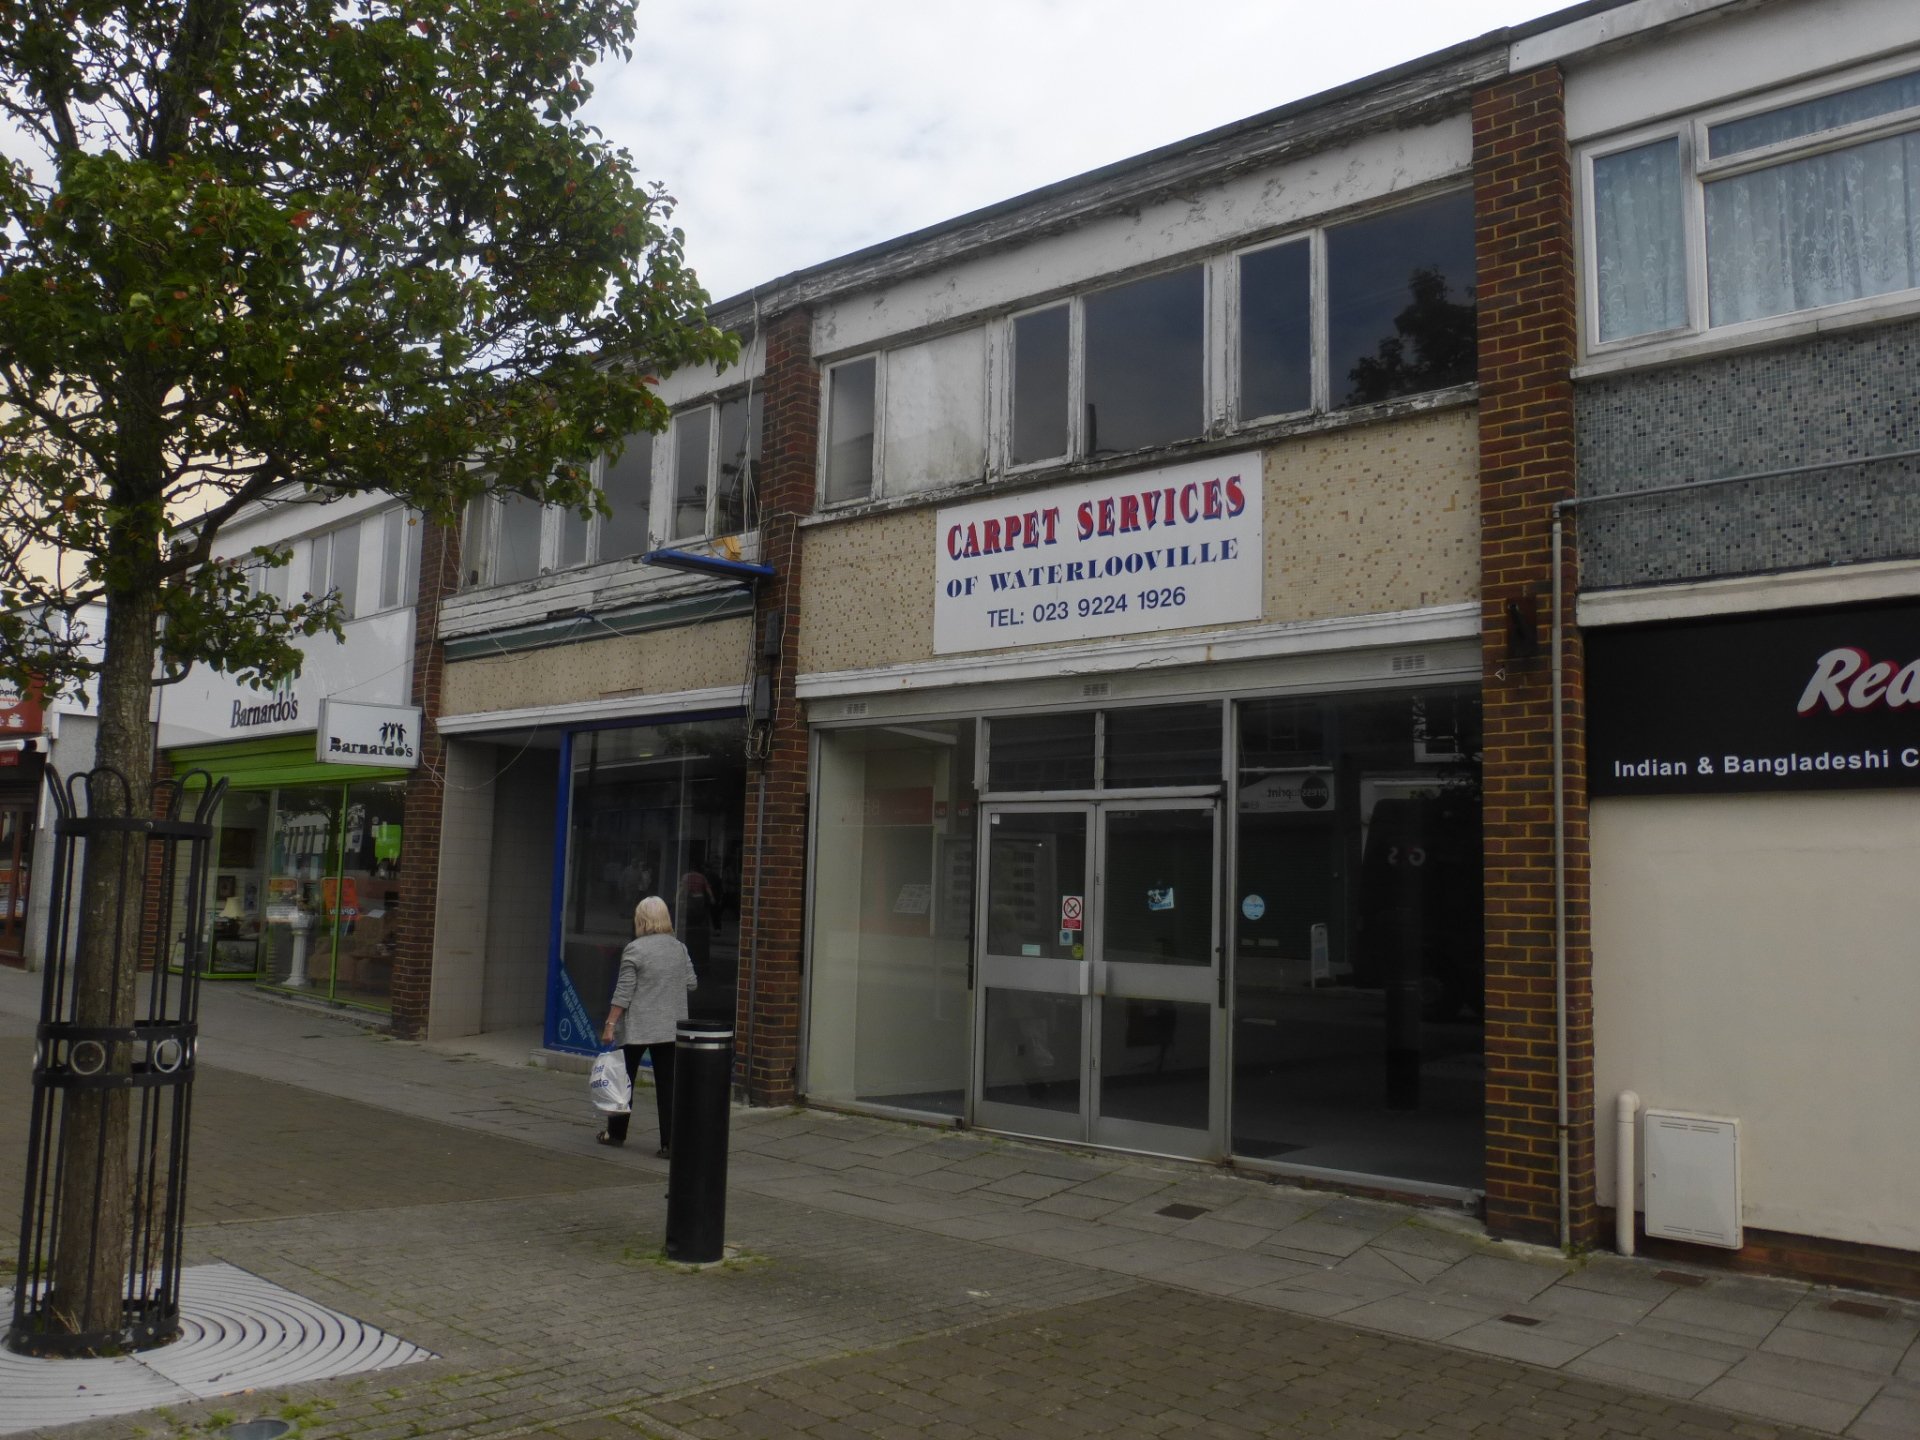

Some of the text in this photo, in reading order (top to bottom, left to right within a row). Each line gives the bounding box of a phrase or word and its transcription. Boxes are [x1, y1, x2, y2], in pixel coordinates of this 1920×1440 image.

[947, 474, 1246, 561] CARPET SERVICES
[946, 538, 1239, 599] OF WATERLOOVILLE
[986, 586, 1187, 628] TEL: 023 9224 1926
[230, 691, 298, 728] Barnardo's
[328, 736, 413, 758] Barnardo's
[1613, 759, 1688, 777] Indian
[1696, 756, 1714, 774] &
[1723, 749, 1889, 776] Bangladeshi
